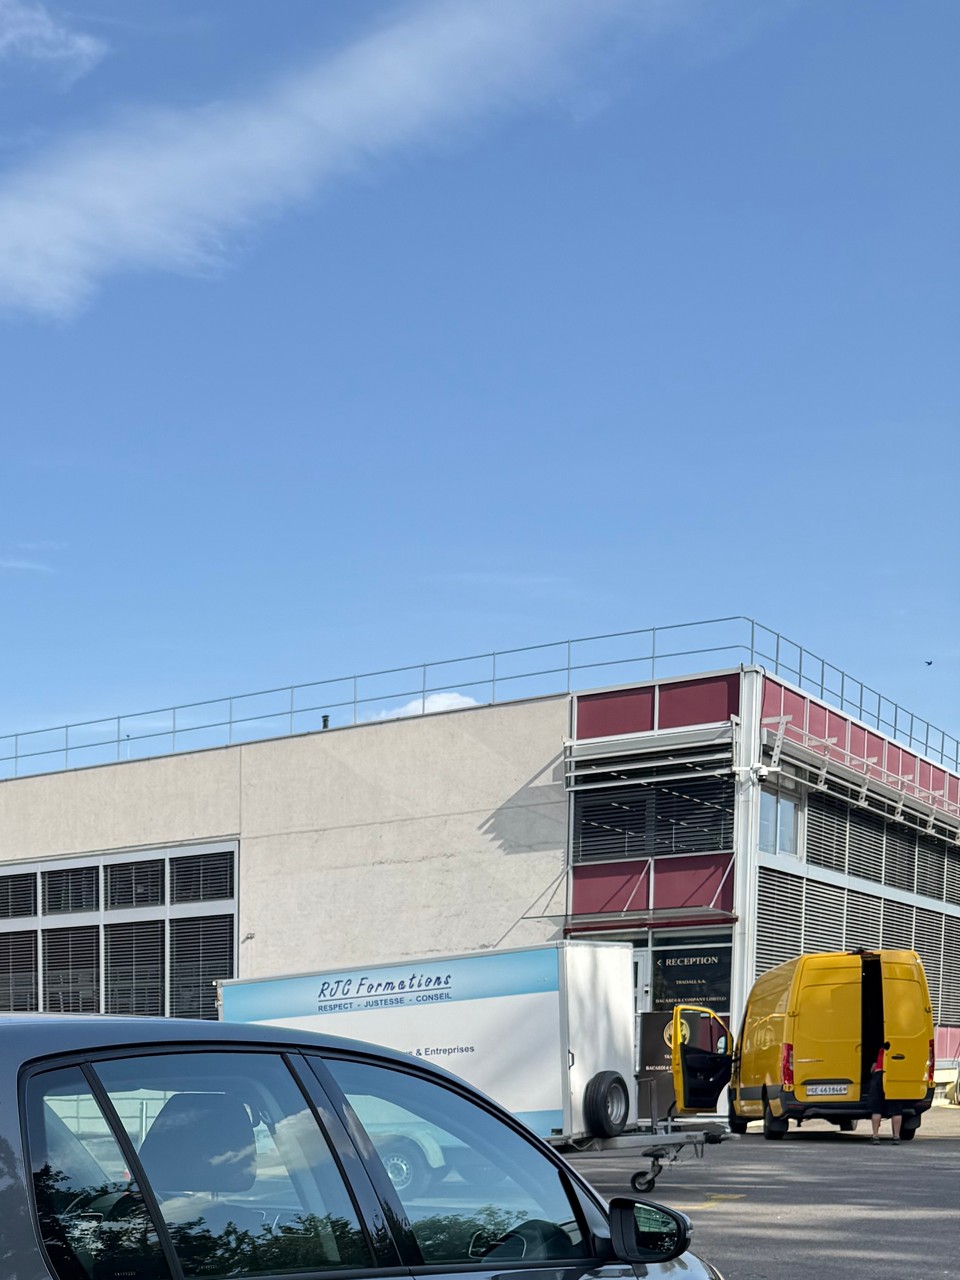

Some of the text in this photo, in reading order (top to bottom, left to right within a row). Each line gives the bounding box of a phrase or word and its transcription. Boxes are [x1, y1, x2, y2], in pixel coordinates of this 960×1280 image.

[665, 956, 718, 966] RECEPTION
[318, 973, 452, 998] RJC Formations
[318, 1002, 353, 1012] RESPECT
[364, 997, 405, 1008] JUSTESSE
[416, 992, 452, 1003] CONSEIL
[415, 1048, 422, 1056] &
[424, 1045, 475, 1056] Entreprises
